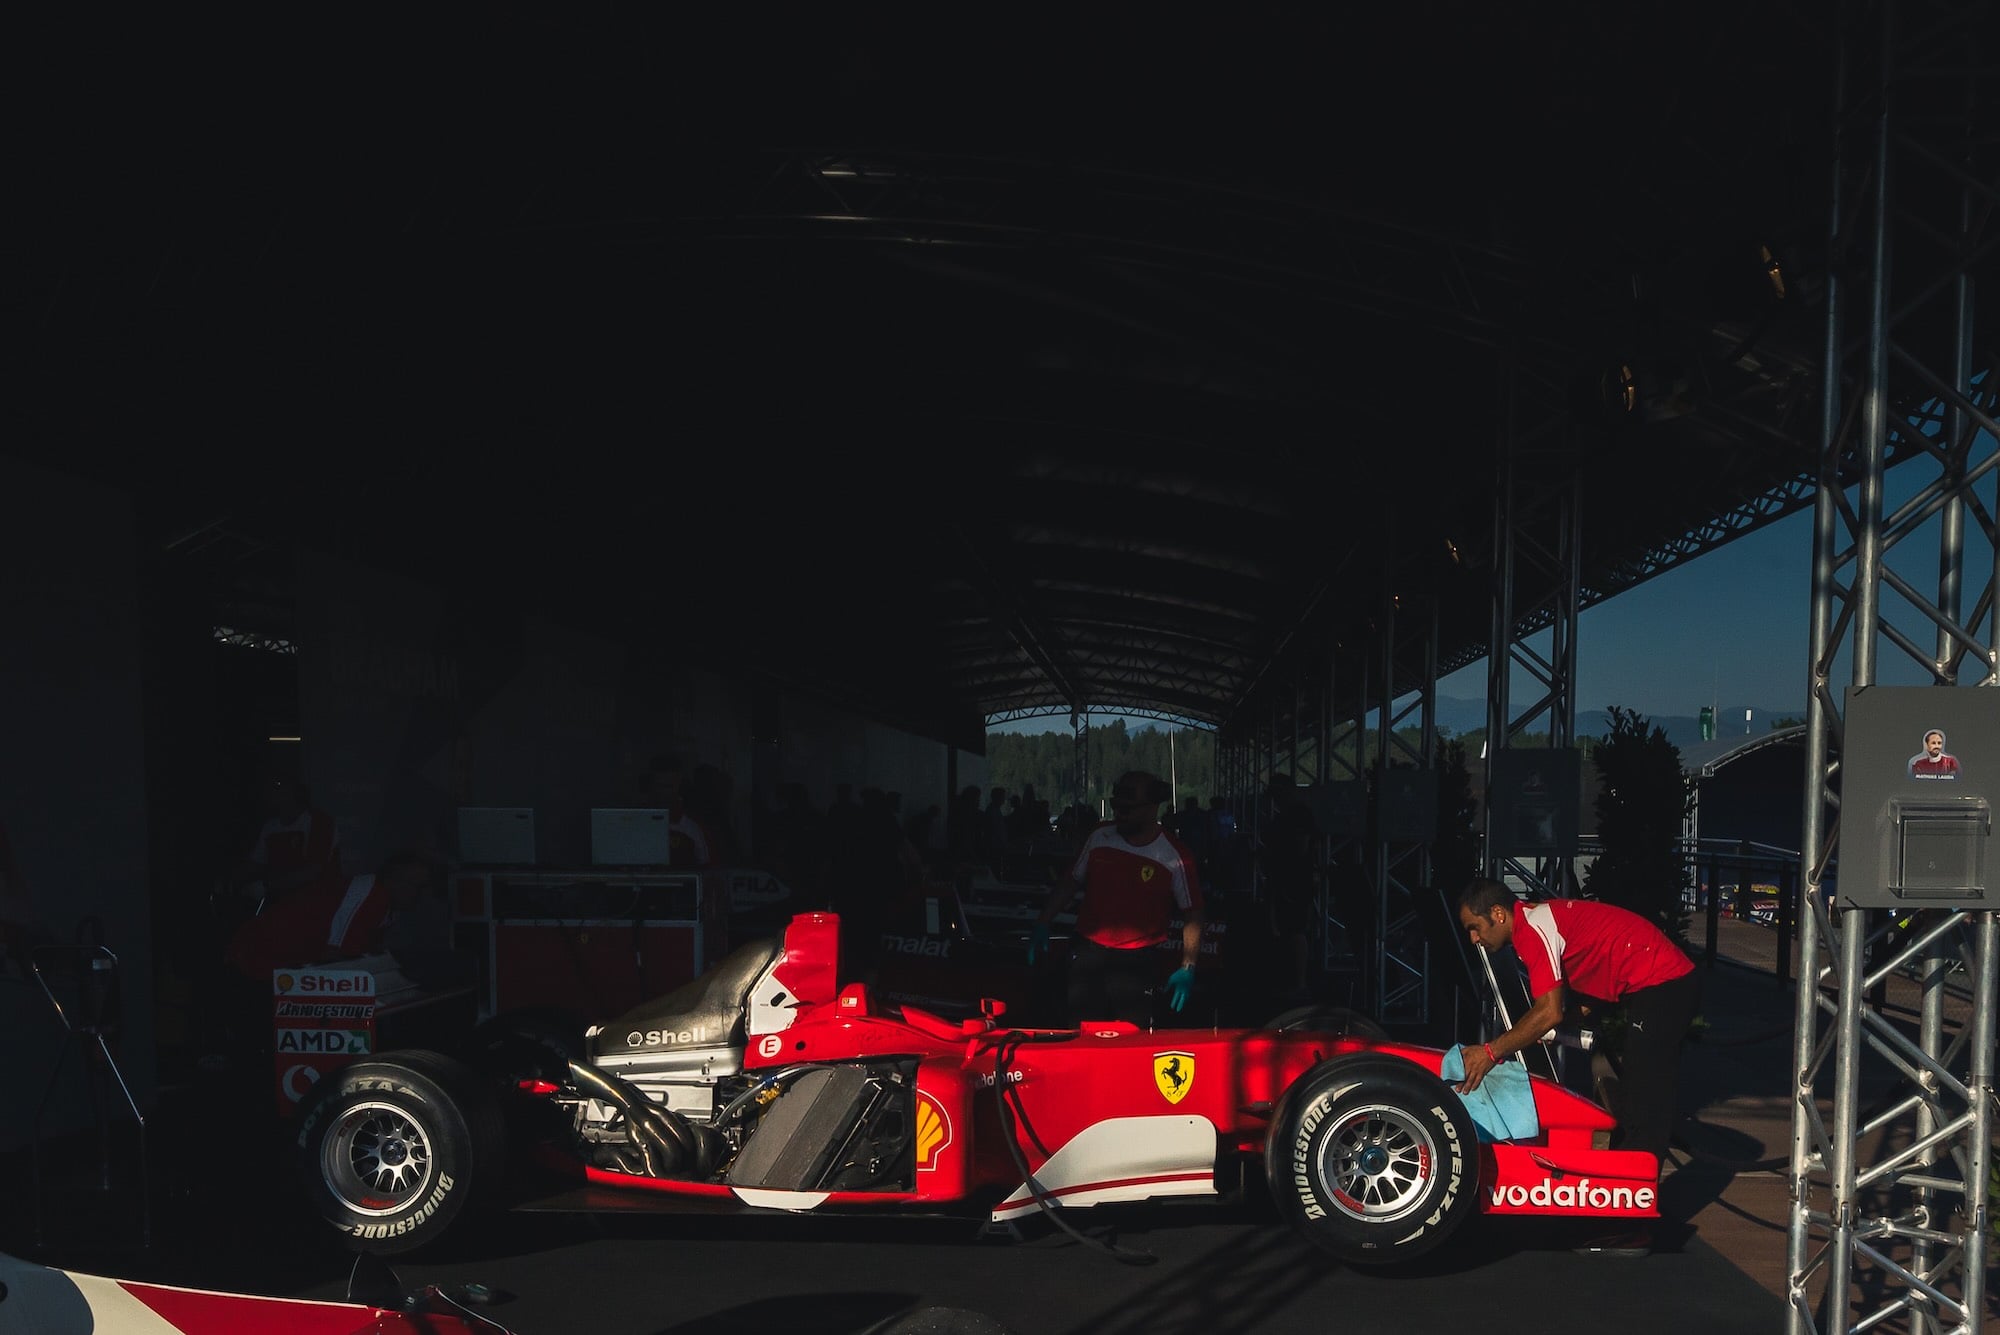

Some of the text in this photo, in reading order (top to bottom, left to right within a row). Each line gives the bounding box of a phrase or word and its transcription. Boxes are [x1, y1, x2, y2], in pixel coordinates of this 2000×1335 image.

[733, 877, 779, 893] FILA
[300, 975, 369, 993] Shell
[276, 1000, 375, 1018] BRIDGESTONE
[279, 1031, 345, 1052] AMD
[645, 1027, 706, 1045] Shell
[764, 1039, 776, 1054] E
[1293, 1098, 1333, 1221] BRIDGESTONE
[1425, 1105, 1463, 1226] POTENZA
[1488, 1178, 1655, 1209] vodafone
[352, 1171, 456, 1239] BRIDGESTONE
